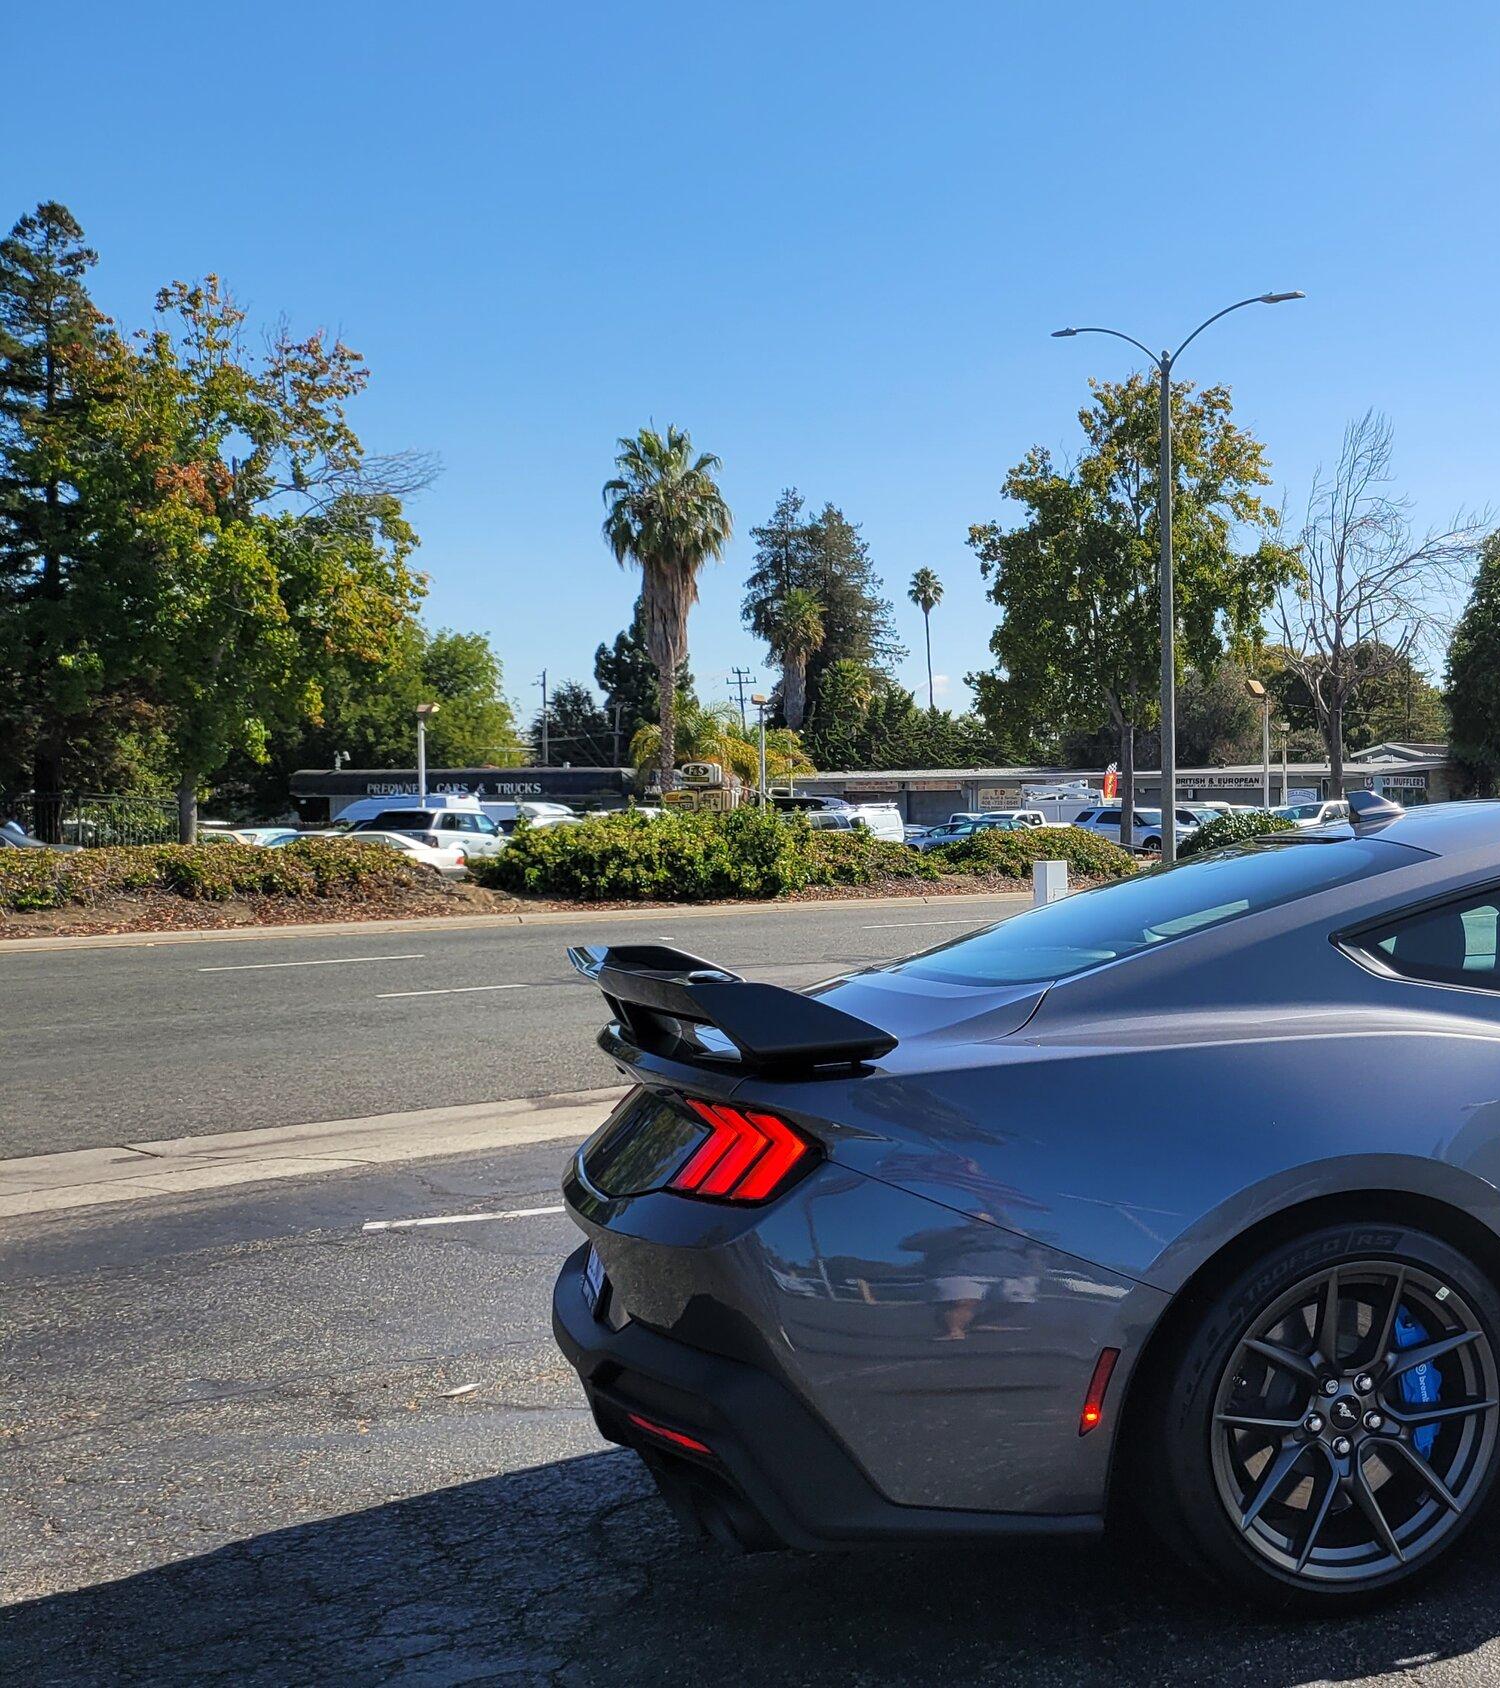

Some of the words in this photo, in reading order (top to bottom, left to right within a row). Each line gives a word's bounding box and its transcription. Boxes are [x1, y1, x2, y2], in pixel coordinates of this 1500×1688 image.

[1393, 777, 1424, 786] MUFFLERS
[436, 783, 469, 794] CARS
[496, 782, 542, 794] TRUCKS
[1356, 1233, 1393, 1246] RS
[1419, 1375, 1430, 1403] bremb
